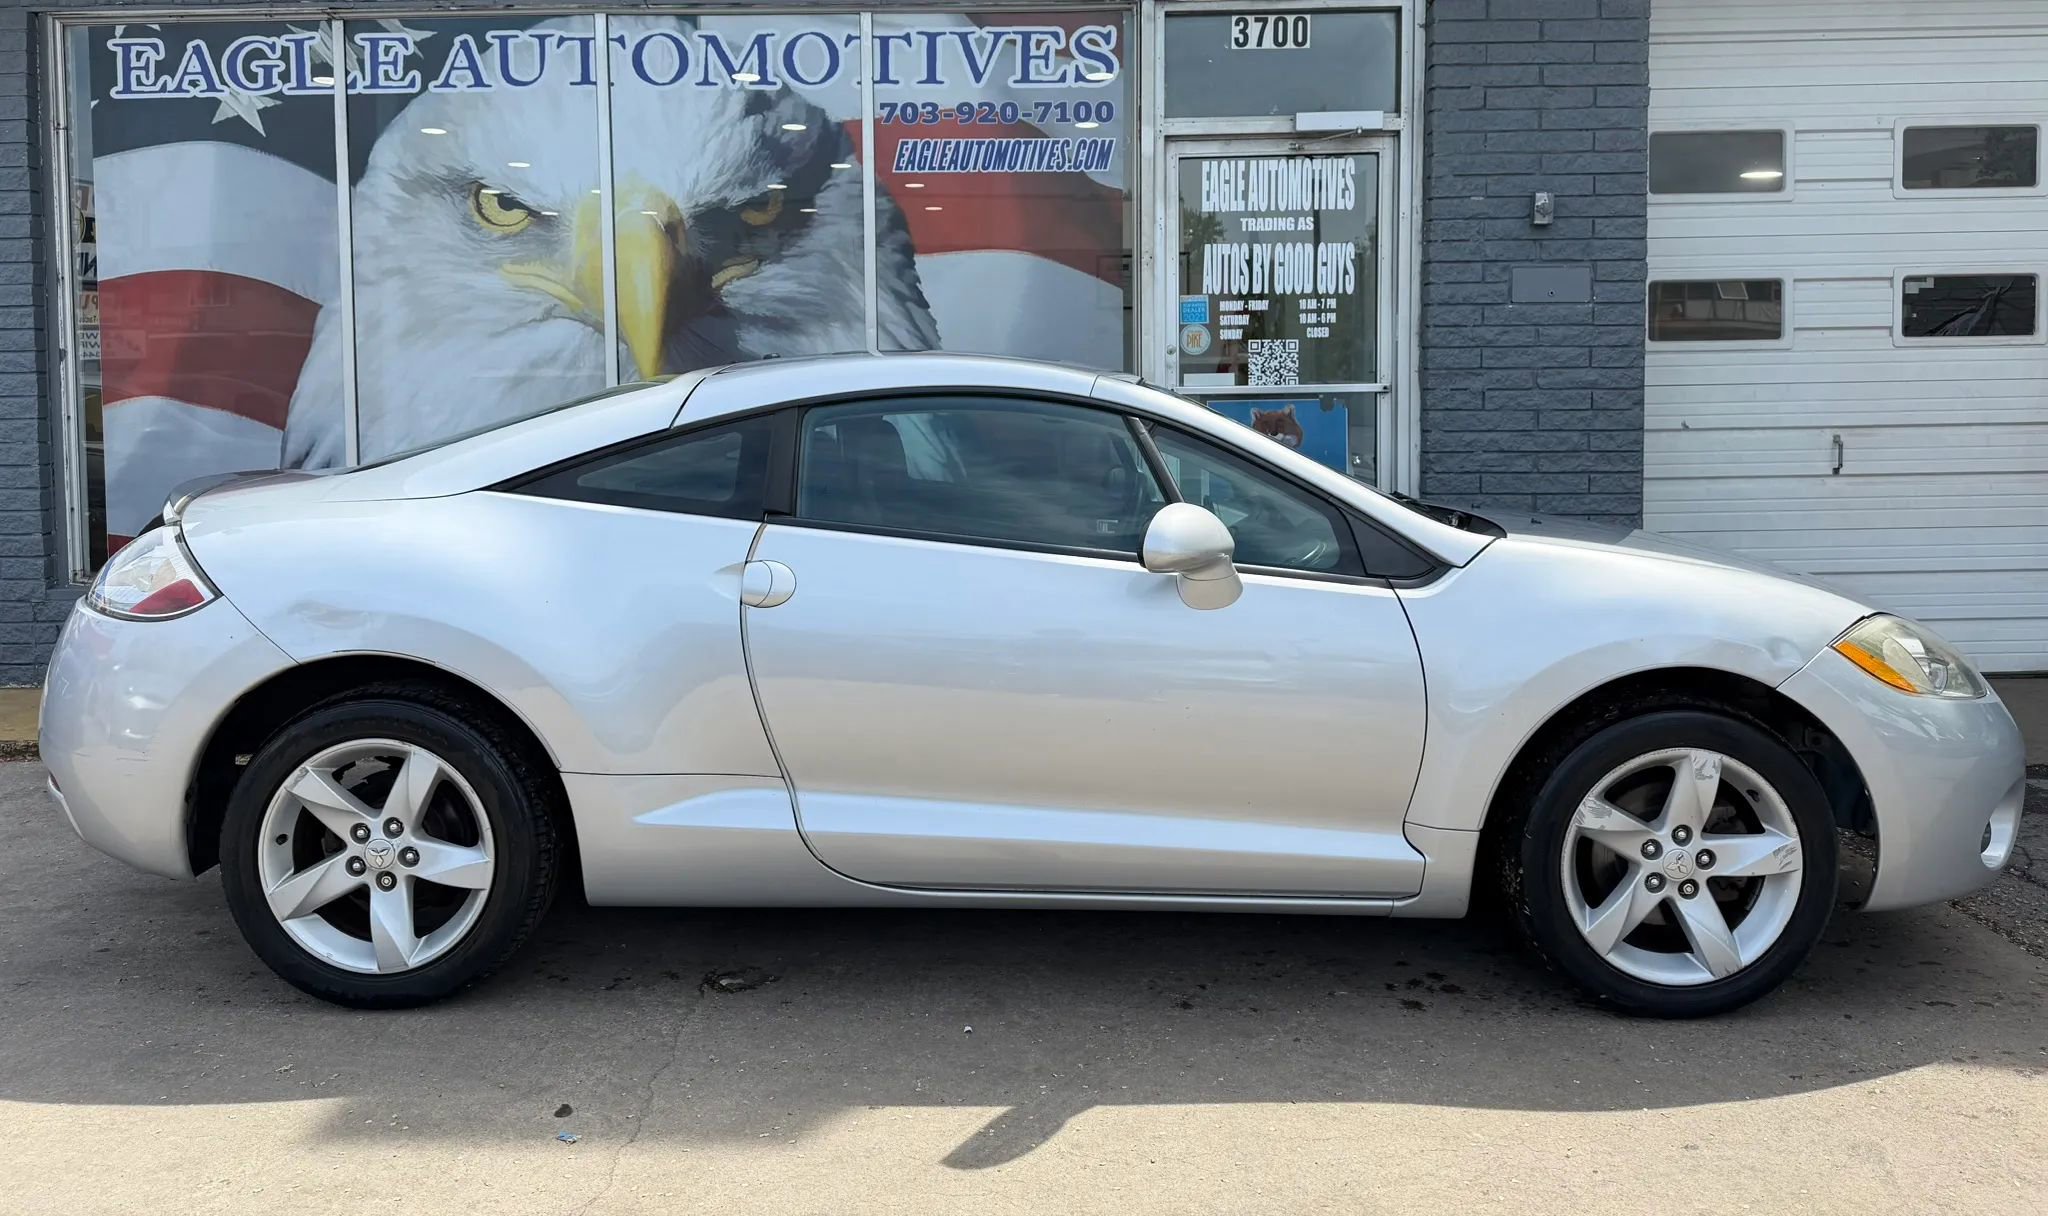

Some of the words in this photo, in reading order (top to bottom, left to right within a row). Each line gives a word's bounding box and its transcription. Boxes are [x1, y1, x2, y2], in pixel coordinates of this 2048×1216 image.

[1233, 15, 1308, 48] 3700
[109, 33, 420, 97] EAGLE
[429, 26, 1118, 91] AUTOMOTIVES
[880, 101, 1115, 125] 703-920-7100
[893, 138, 1115, 172] EAGLEAUTOMOTIVES.COM
[1201, 160, 1245, 212] EAGLE
[1247, 157, 1355, 212] AUTOMOTIVES
[1240, 217, 1295, 231] TRADING
[1297, 216, 1314, 231] AS
[1202, 243, 1249, 295] AUTOS
[1252, 243, 1272, 295] BY
[1274, 242, 1314, 295] GOOD
[1317, 242, 1355, 295] GUYS
[1220, 300, 1244, 311] MONDAY
[1248, 300, 1269, 311] FRIDAY
[1299, 299, 1306, 310] 10
[1307, 298, 1317, 309] AM
[1326, 298, 1336, 309] PM
[1220, 315, 1250, 325] SATURDAY
[1299, 313, 1306, 324] 10
[1307, 313, 1317, 324] AM
[1326, 312, 1336, 323] PM
[1220, 328, 1243, 340] SUNDAY
[1306, 327, 1329, 338] CLOSED
